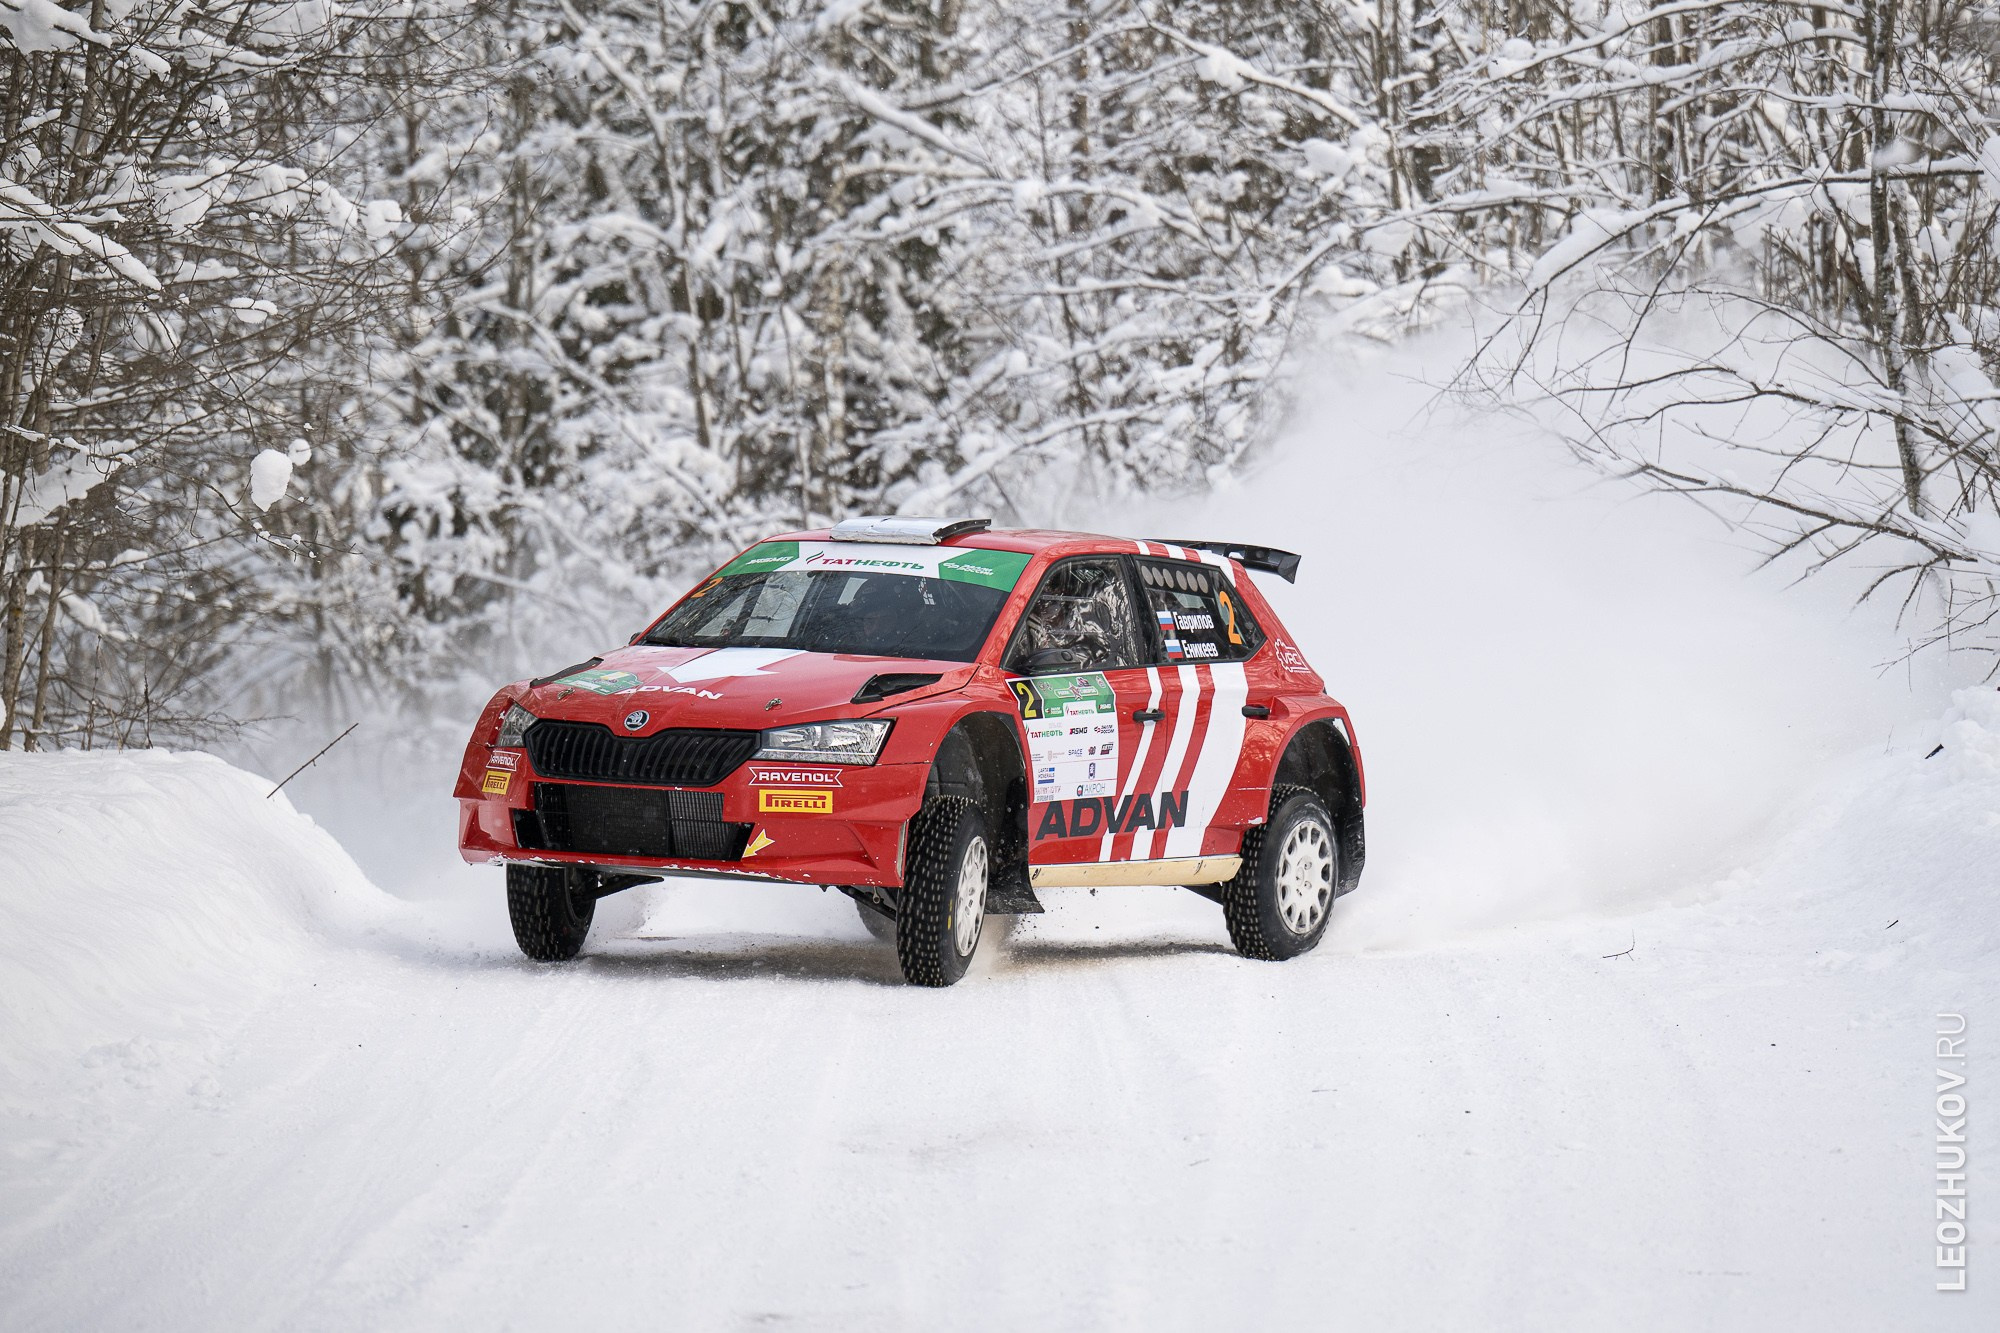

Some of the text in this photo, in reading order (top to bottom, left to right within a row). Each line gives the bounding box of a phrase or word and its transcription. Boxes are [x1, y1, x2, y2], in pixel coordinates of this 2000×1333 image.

[822, 558, 924, 570] ТАТНЕФТЬ
[1173, 612, 1214, 633] Гаврилов
[1219, 590, 1242, 645] 2
[1181, 640, 1219, 659] Еникеев
[615, 685, 724, 700] ADVAN
[1016, 682, 1037, 718] 2
[1030, 729, 1063, 739] ТАТНЕФТЬ
[485, 775, 508, 790] PIRELLI
[759, 772, 834, 782] RAVENOL
[765, 793, 827, 809] PIRELLI
[1035, 790, 1189, 841] ADVAN
